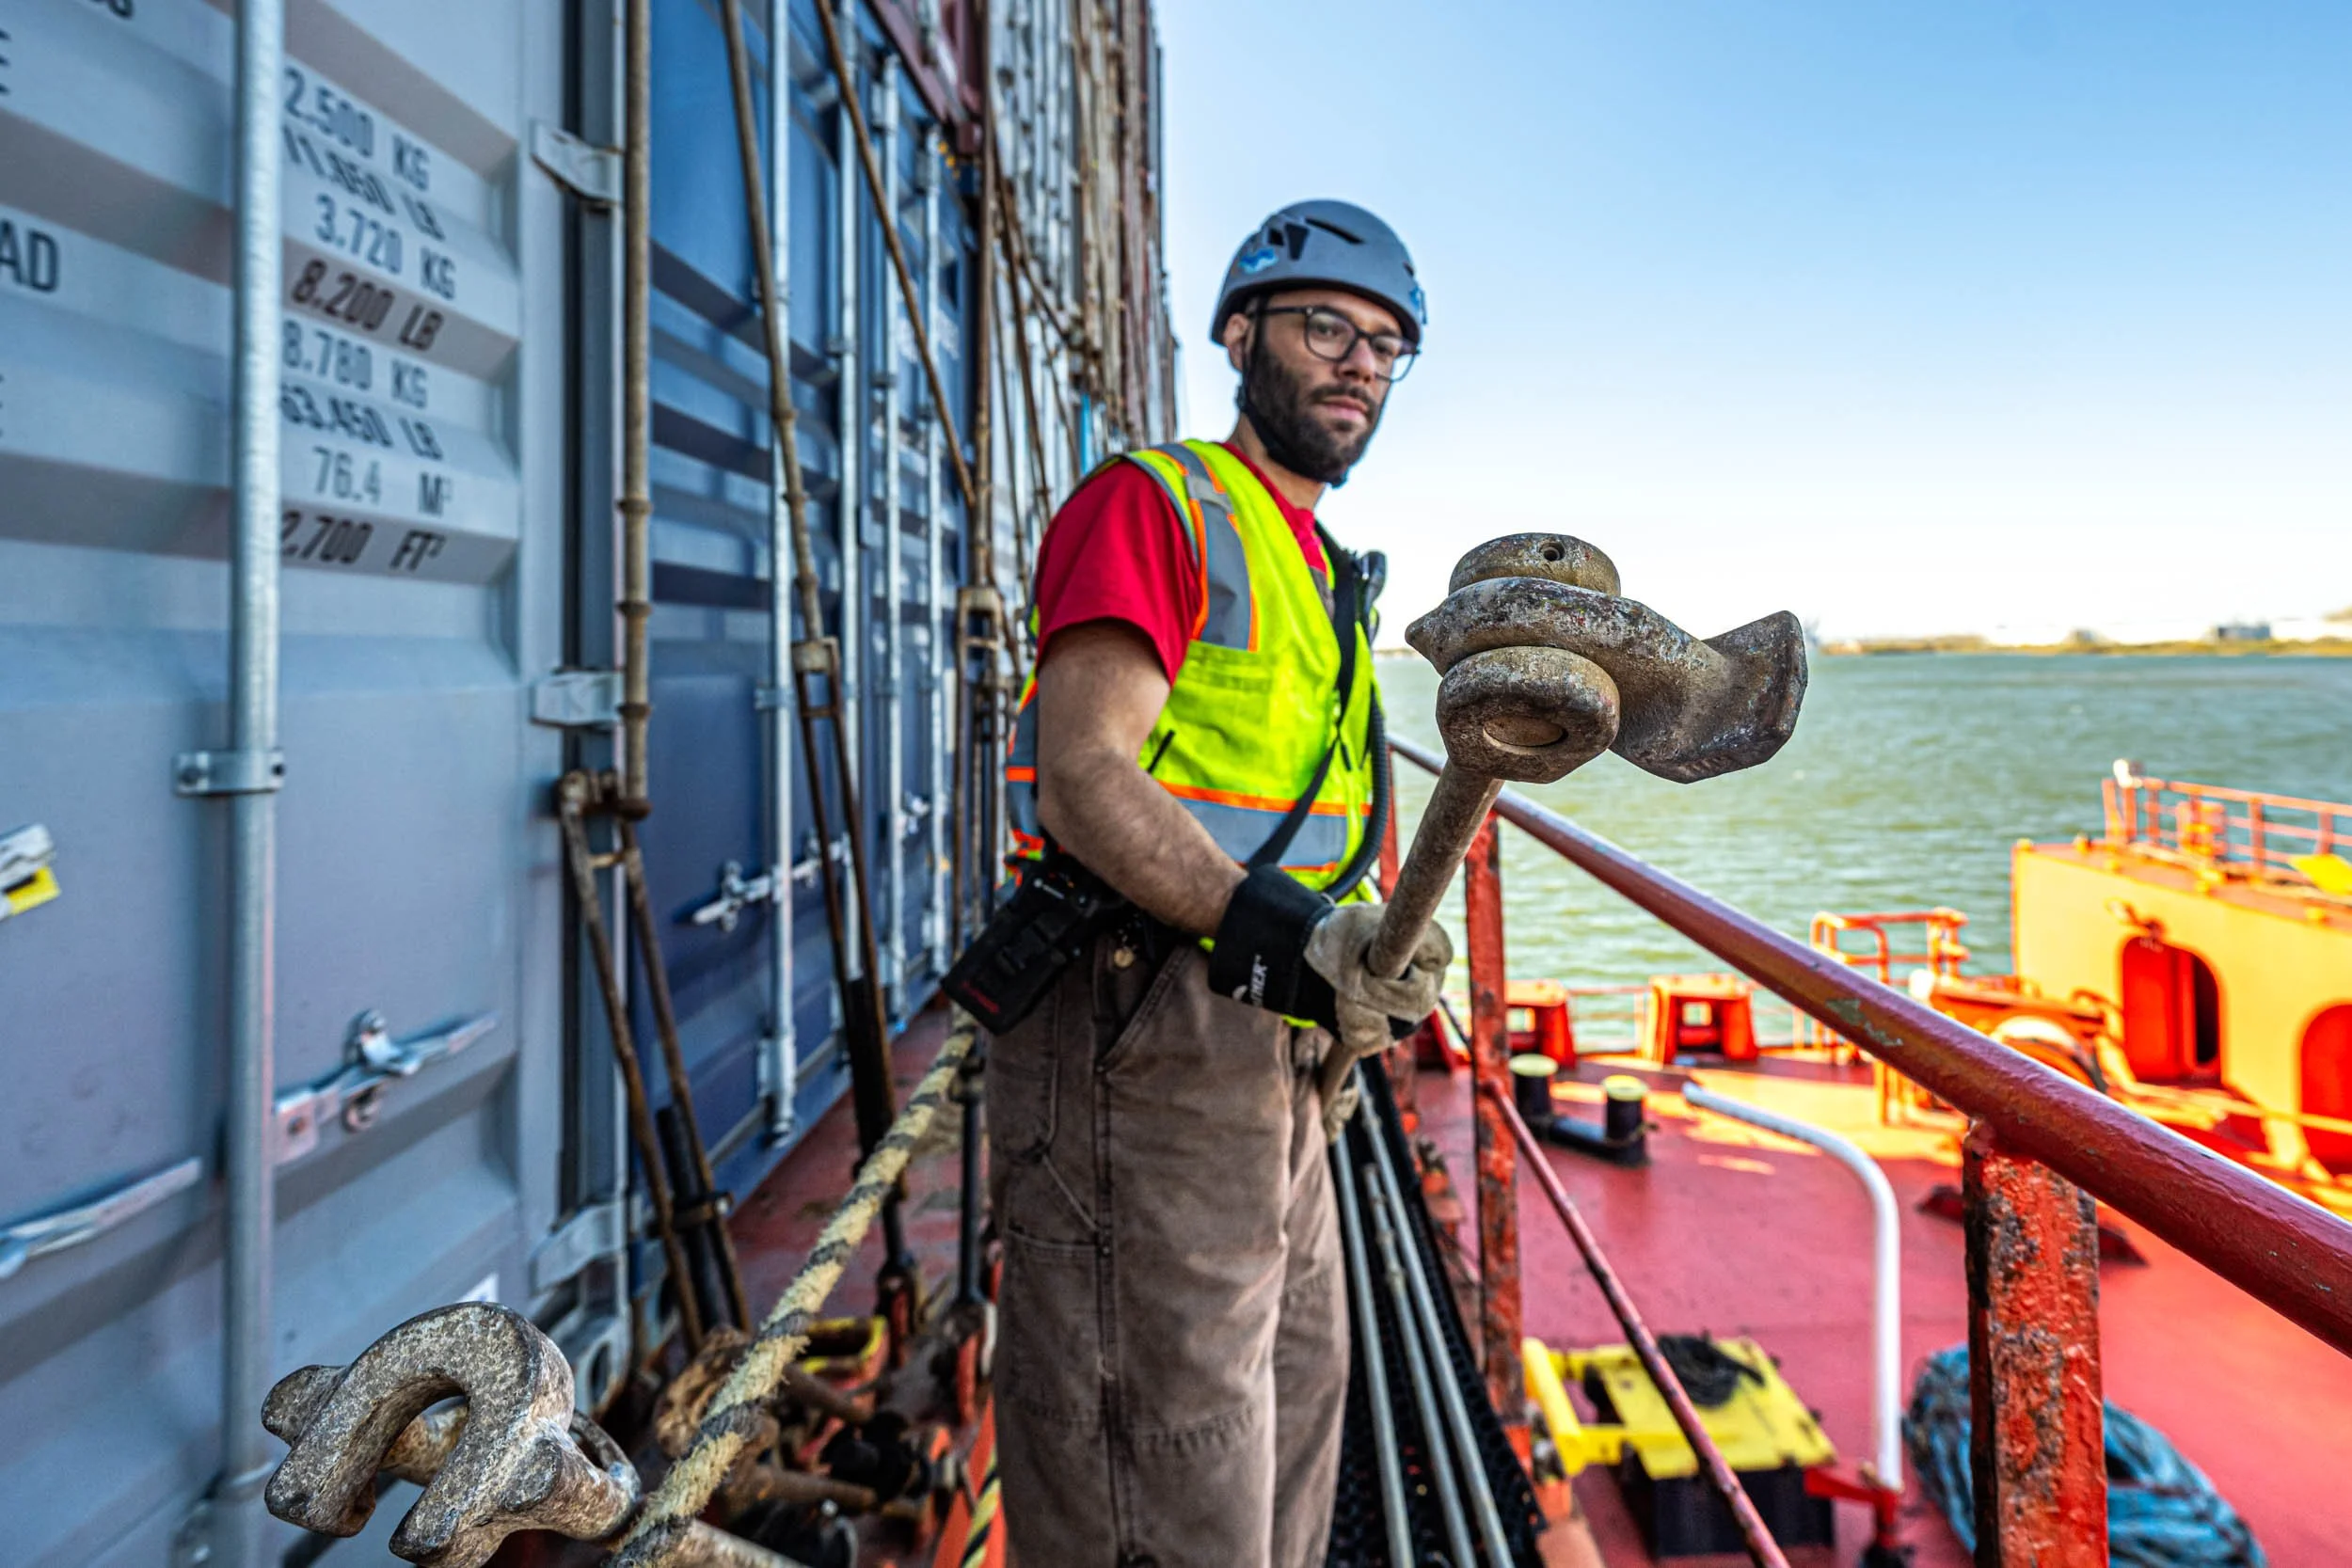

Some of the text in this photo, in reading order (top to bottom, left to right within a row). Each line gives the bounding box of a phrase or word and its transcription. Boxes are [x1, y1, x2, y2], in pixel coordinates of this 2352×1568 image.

[392, 134, 431, 192] KG
[399, 191, 445, 242] LB
[315, 193, 456, 301] 3.720 KG
[292, 258, 445, 352] 8.200 LB
[390, 357, 428, 409] KG
[398, 417, 443, 460] LB
[312, 446, 380, 505] 76.4
